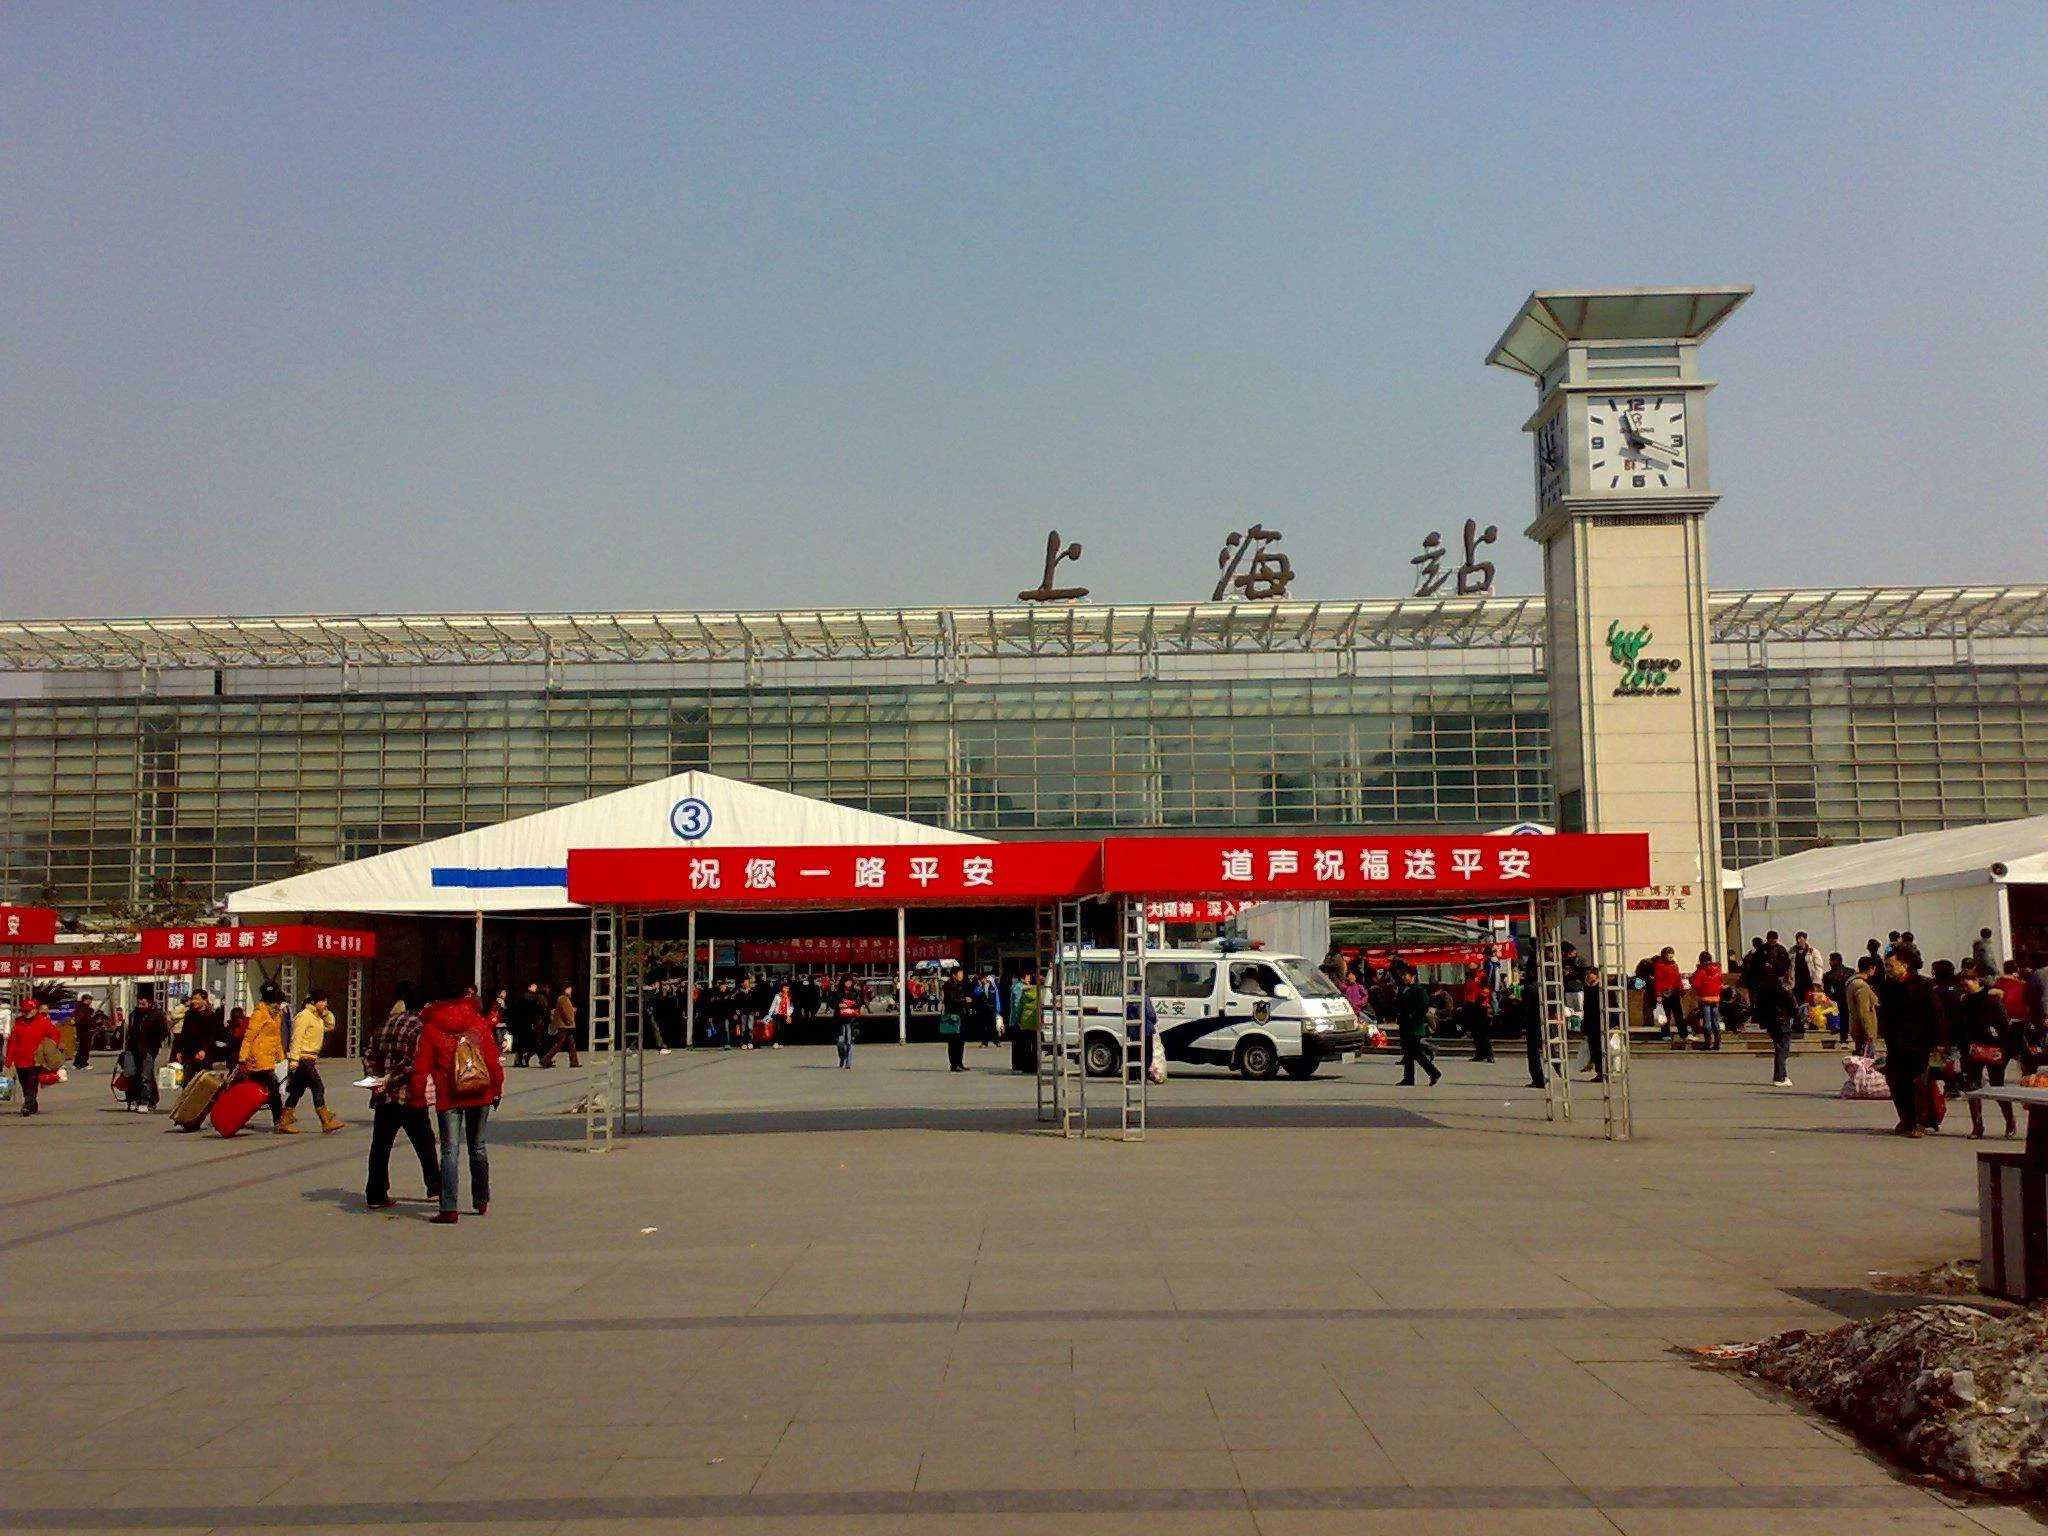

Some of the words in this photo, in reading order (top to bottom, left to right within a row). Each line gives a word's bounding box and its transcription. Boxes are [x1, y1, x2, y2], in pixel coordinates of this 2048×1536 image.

[1671, 434, 1684, 447] 3
[1018, 518, 1498, 602] 上海站
[688, 856, 994, 890] 祝您一路平安
[1221, 848, 1532, 882] 道声祝福送平安
[1155, 1000, 1186, 1015] 公安
